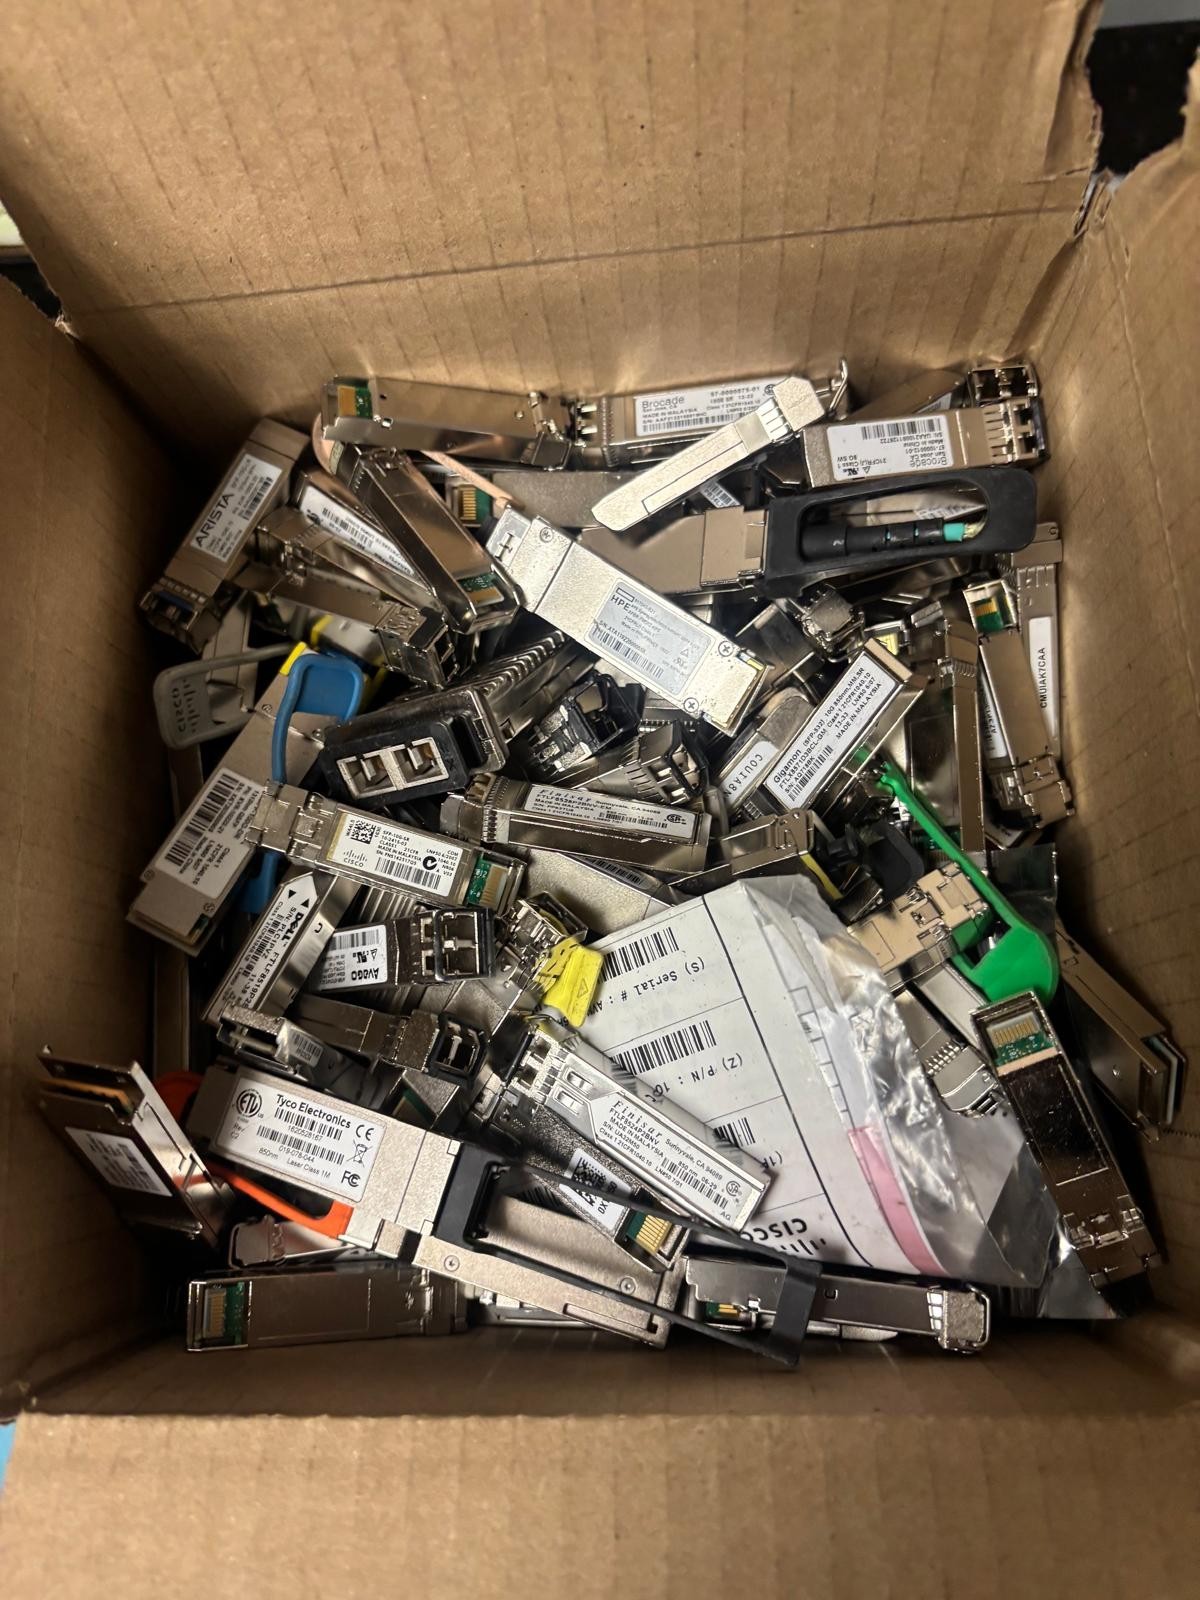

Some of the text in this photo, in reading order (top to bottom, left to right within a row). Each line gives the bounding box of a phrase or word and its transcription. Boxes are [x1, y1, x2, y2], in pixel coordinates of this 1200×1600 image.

[641, 395, 684, 409] Brocade
[667, 407, 697, 415] MALAYSIA
[902, 440, 920, 448] China
[841, 460, 859, 468] Class
[909, 455, 947, 468] Brocade
[192, 489, 235, 547] ARISTA
[609, 594, 631, 612] HPE
[835, 681, 882, 739] MADE IN MALAYSIA
[825, 711, 840, 728] Class
[772, 747, 803, 784] Gigamon
[539, 788, 592, 802] Finisar
[784, 780, 796, 793] S/N:
[562, 803, 594, 812] MALAYSIA
[193, 835, 208, 853] Made
[377, 844, 392, 853] MADE
[397, 850, 422, 862] MALAYSIA
[403, 847, 419, 855] 21CFR
[214, 846, 230, 866] Class
[178, 856, 193, 875] China
[270, 900, 284, 918] Class
[283, 905, 297, 923] S/N:
[682, 955, 705, 976] (S)
[632, 969, 679, 996] Serial
[618, 989, 628, 1002] #
[720, 1052, 743, 1071] (Z)
[689, 1063, 715, 1082] P/N
[274, 1094, 352, 1129] Tyco Electronics
[232, 1123, 246, 1133] Rev
[601, 1120, 614, 1131] S/N:
[607, 1107, 660, 1146] FTLF8524P2BNV
[608, 1116, 665, 1158] MADE IN MALAYSIA
[612, 1099, 723, 1180] Finisar Sunnyvale, CA 94089
[278, 1145, 315, 1163] 019-078-044
[598, 1126, 614, 1140] Class
[616, 1139, 653, 1167] 21CFR1040.10
[654, 1164, 673, 1180] LN#50
[258, 1147, 331, 1178] 850nm Laser Class 1M
[688, 1167, 699, 1177] nm
[719, 1210, 732, 1221] AG
